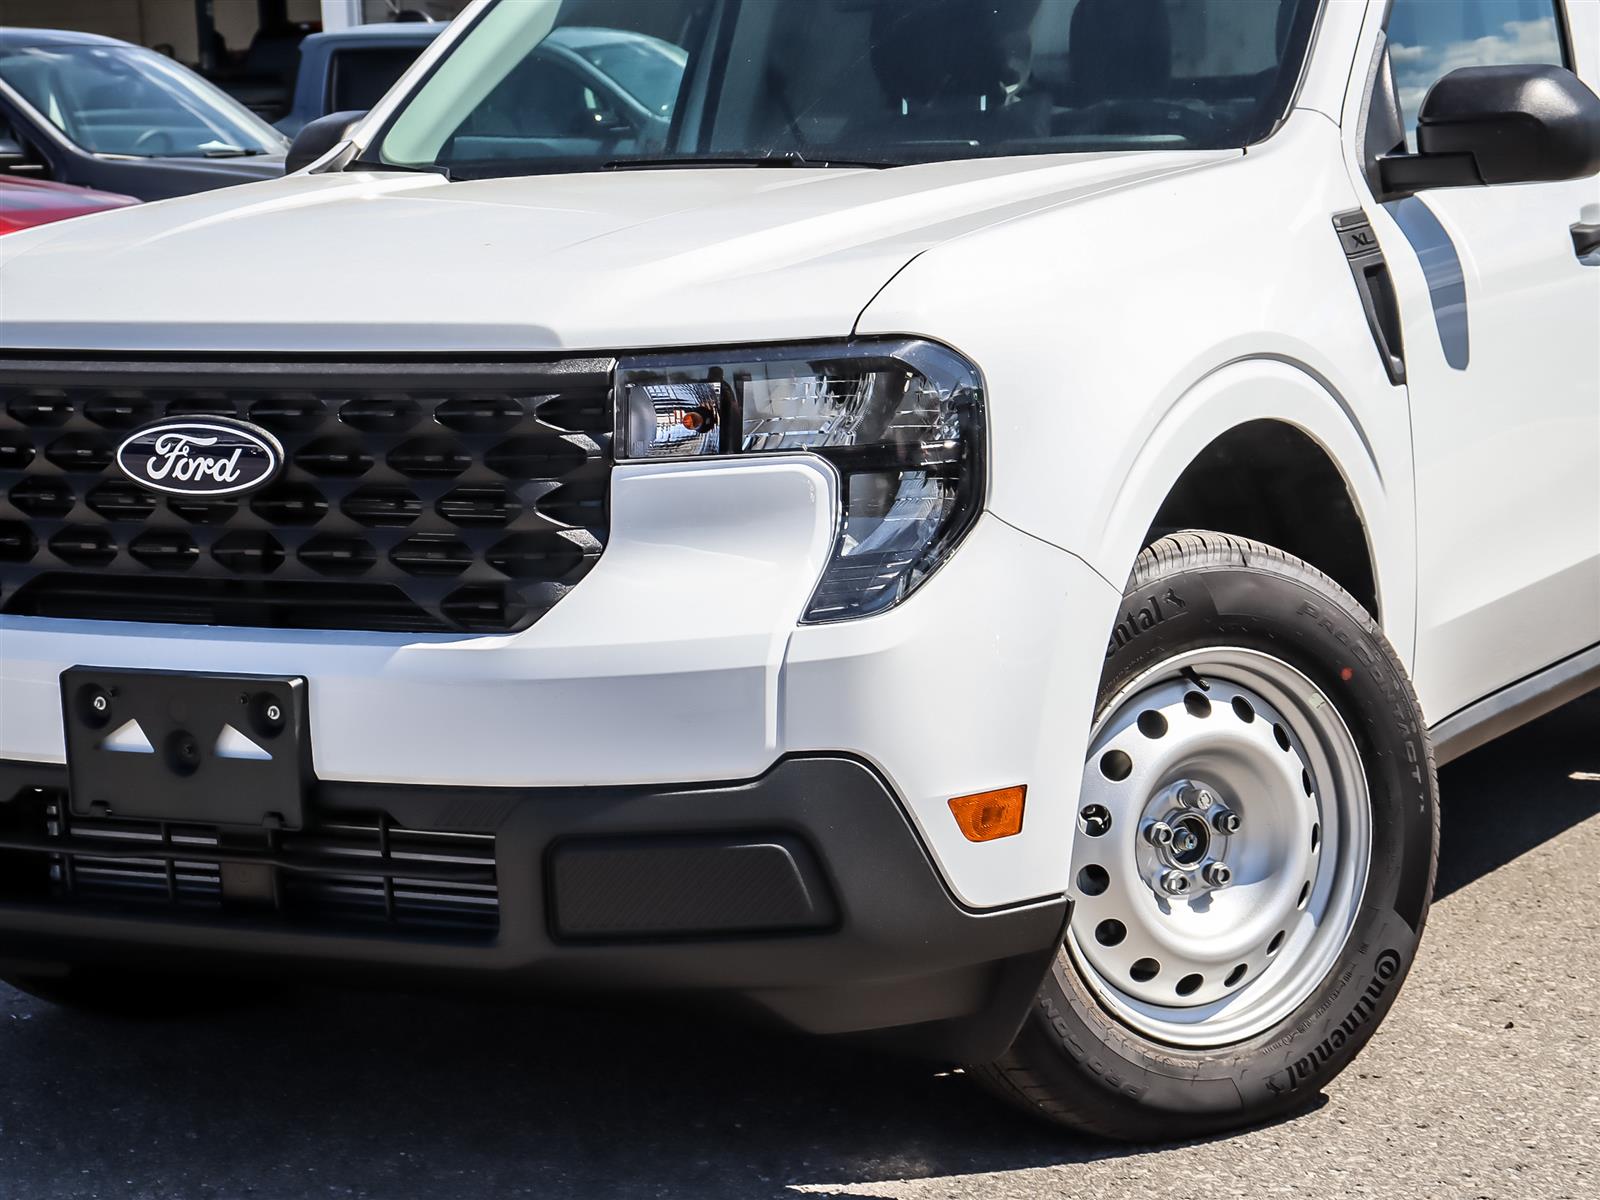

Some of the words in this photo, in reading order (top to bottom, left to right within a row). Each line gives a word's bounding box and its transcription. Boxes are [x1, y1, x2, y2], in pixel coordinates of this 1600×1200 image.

[1351, 232, 1375, 248] XL
[146, 433, 242, 482] Ford
[1284, 948, 1401, 1092] Continental
